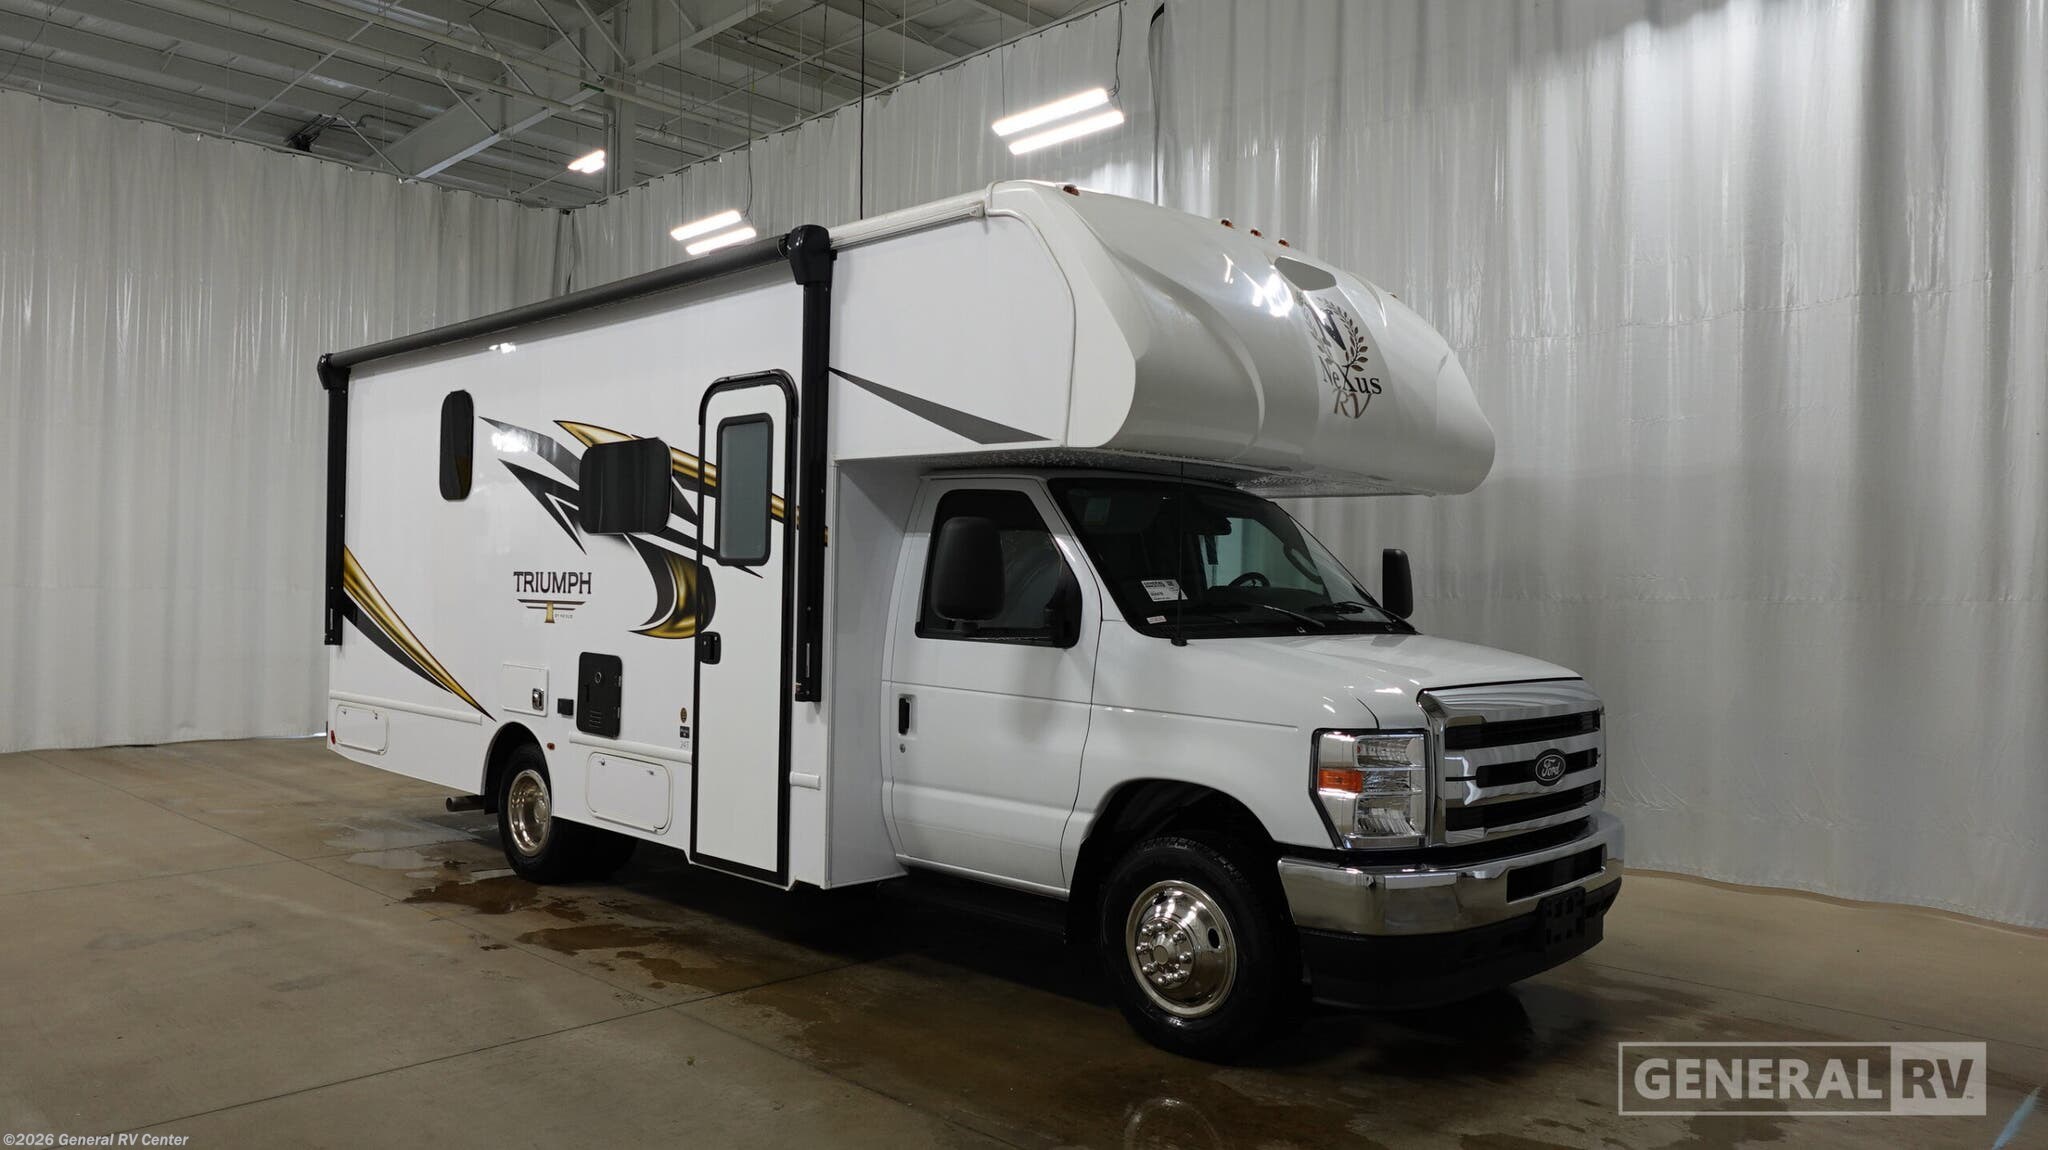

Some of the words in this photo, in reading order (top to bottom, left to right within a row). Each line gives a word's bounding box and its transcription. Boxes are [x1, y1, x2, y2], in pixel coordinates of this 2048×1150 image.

[1332, 389, 1373, 419] RV
[513, 571, 592, 594] TRIUMPH
[1541, 759, 1561, 777] Ford
